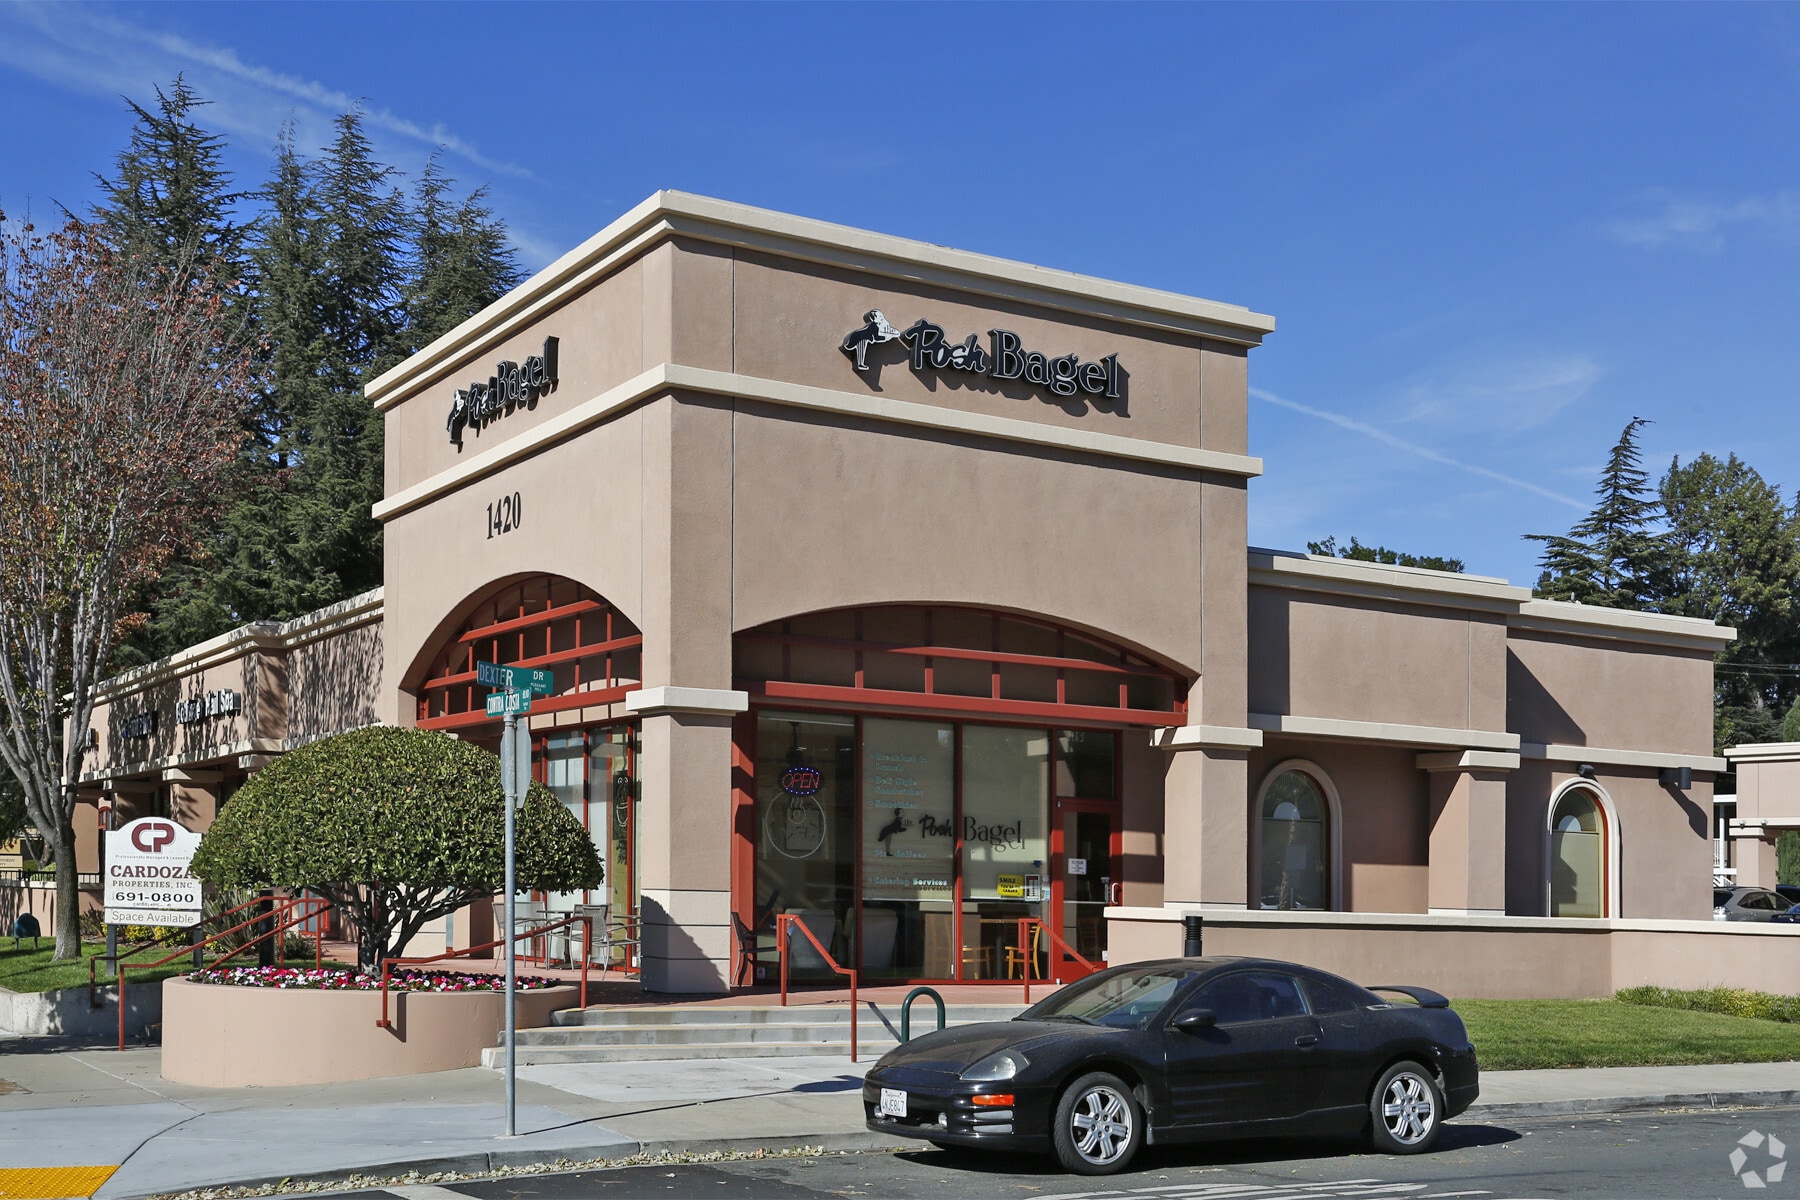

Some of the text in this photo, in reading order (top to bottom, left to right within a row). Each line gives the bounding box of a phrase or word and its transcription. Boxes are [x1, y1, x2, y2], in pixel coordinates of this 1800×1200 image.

[905, 318, 986, 373] Posh
[987, 328, 1120, 398] Bagel
[496, 336, 559, 409] Bagel
[486, 491, 522, 540] 1420
[480, 664, 544, 687] DEXTER DR
[220, 688, 234, 713] Spa
[487, 695, 505, 714] CONTRA
[505, 693, 520, 711] COSTA
[782, 773, 821, 789] OPEN
[919, 814, 953, 839] Posh
[963, 816, 1022, 846] Bagel
[110, 865, 196, 879] CARDOZA
[912, 878, 948, 886] Services
[112, 880, 174, 889] PROPERTIES,
[115, 892, 194, 903] 691-0800
[112, 911, 194, 924] Space Available
